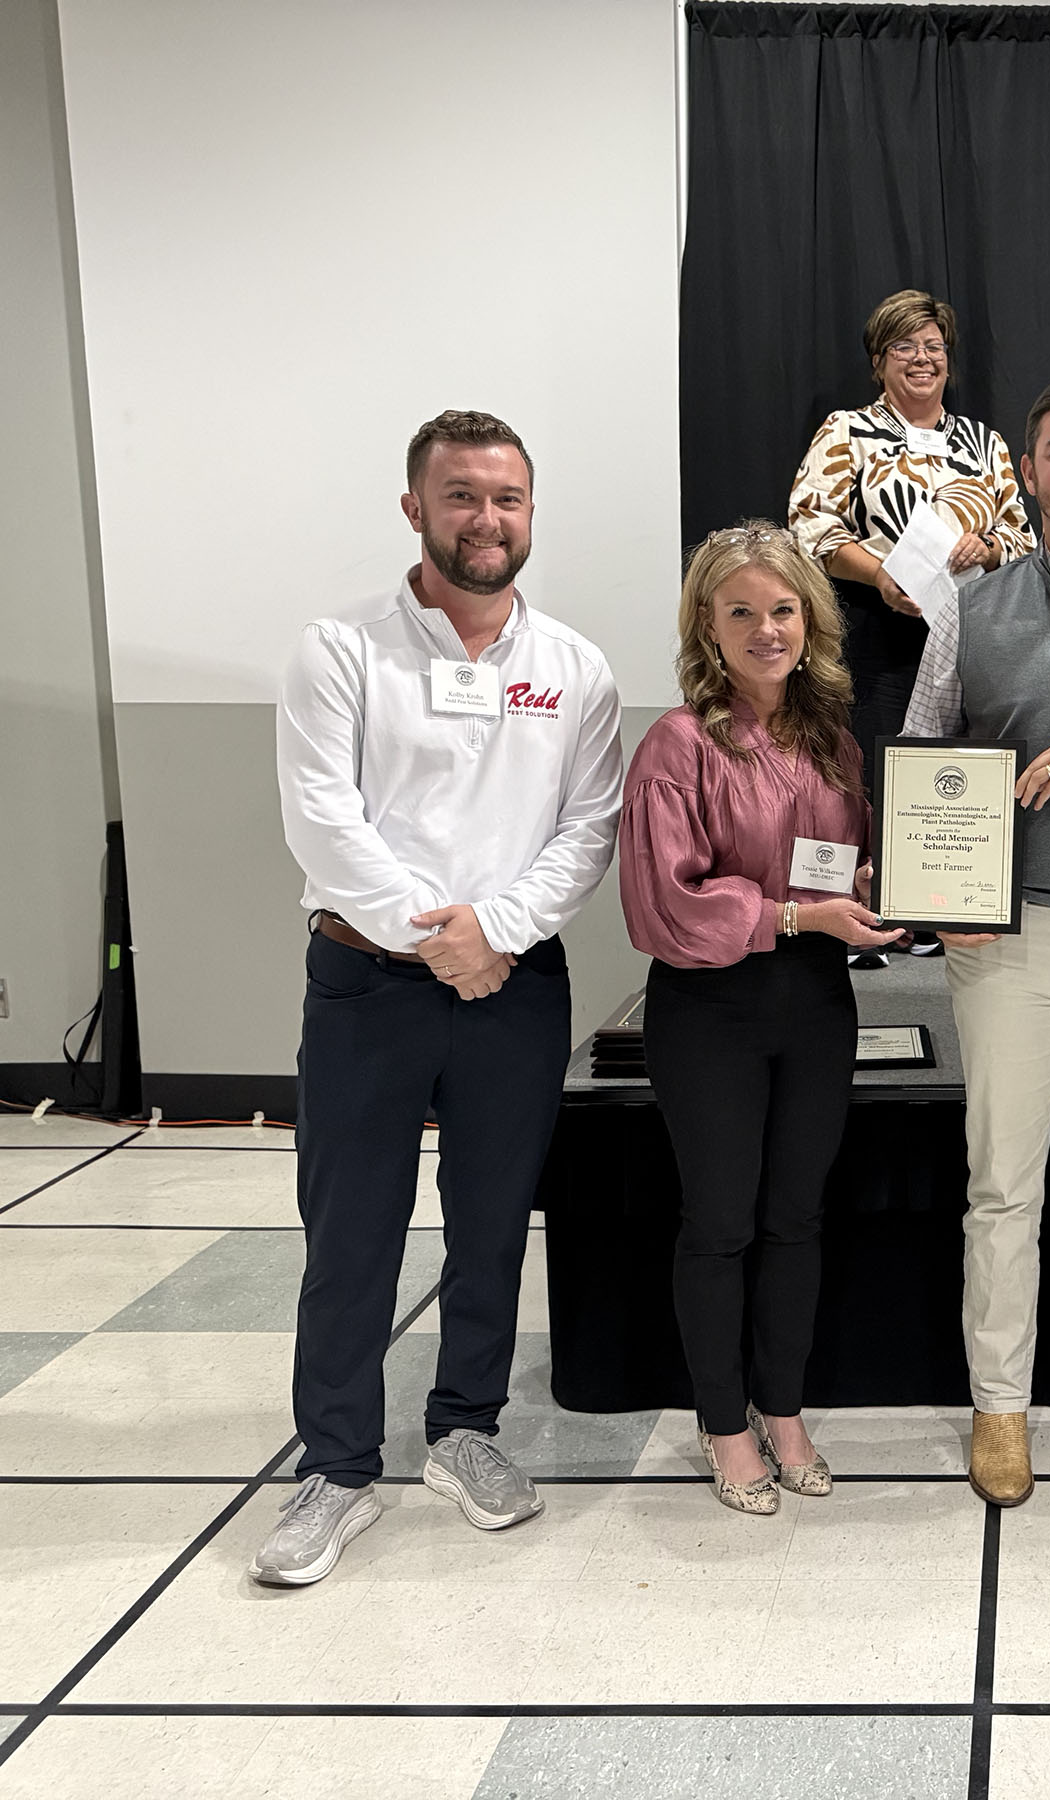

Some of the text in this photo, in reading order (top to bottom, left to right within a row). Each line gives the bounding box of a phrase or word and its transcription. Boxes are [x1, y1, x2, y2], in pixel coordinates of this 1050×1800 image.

[506, 682, 563, 710] Redd
[525, 711, 559, 719] SOLUTIONS
[948, 834, 989, 842] Memorial
[922, 843, 973, 852] Scholarship
[922, 862, 973, 872] Brett Farmer
